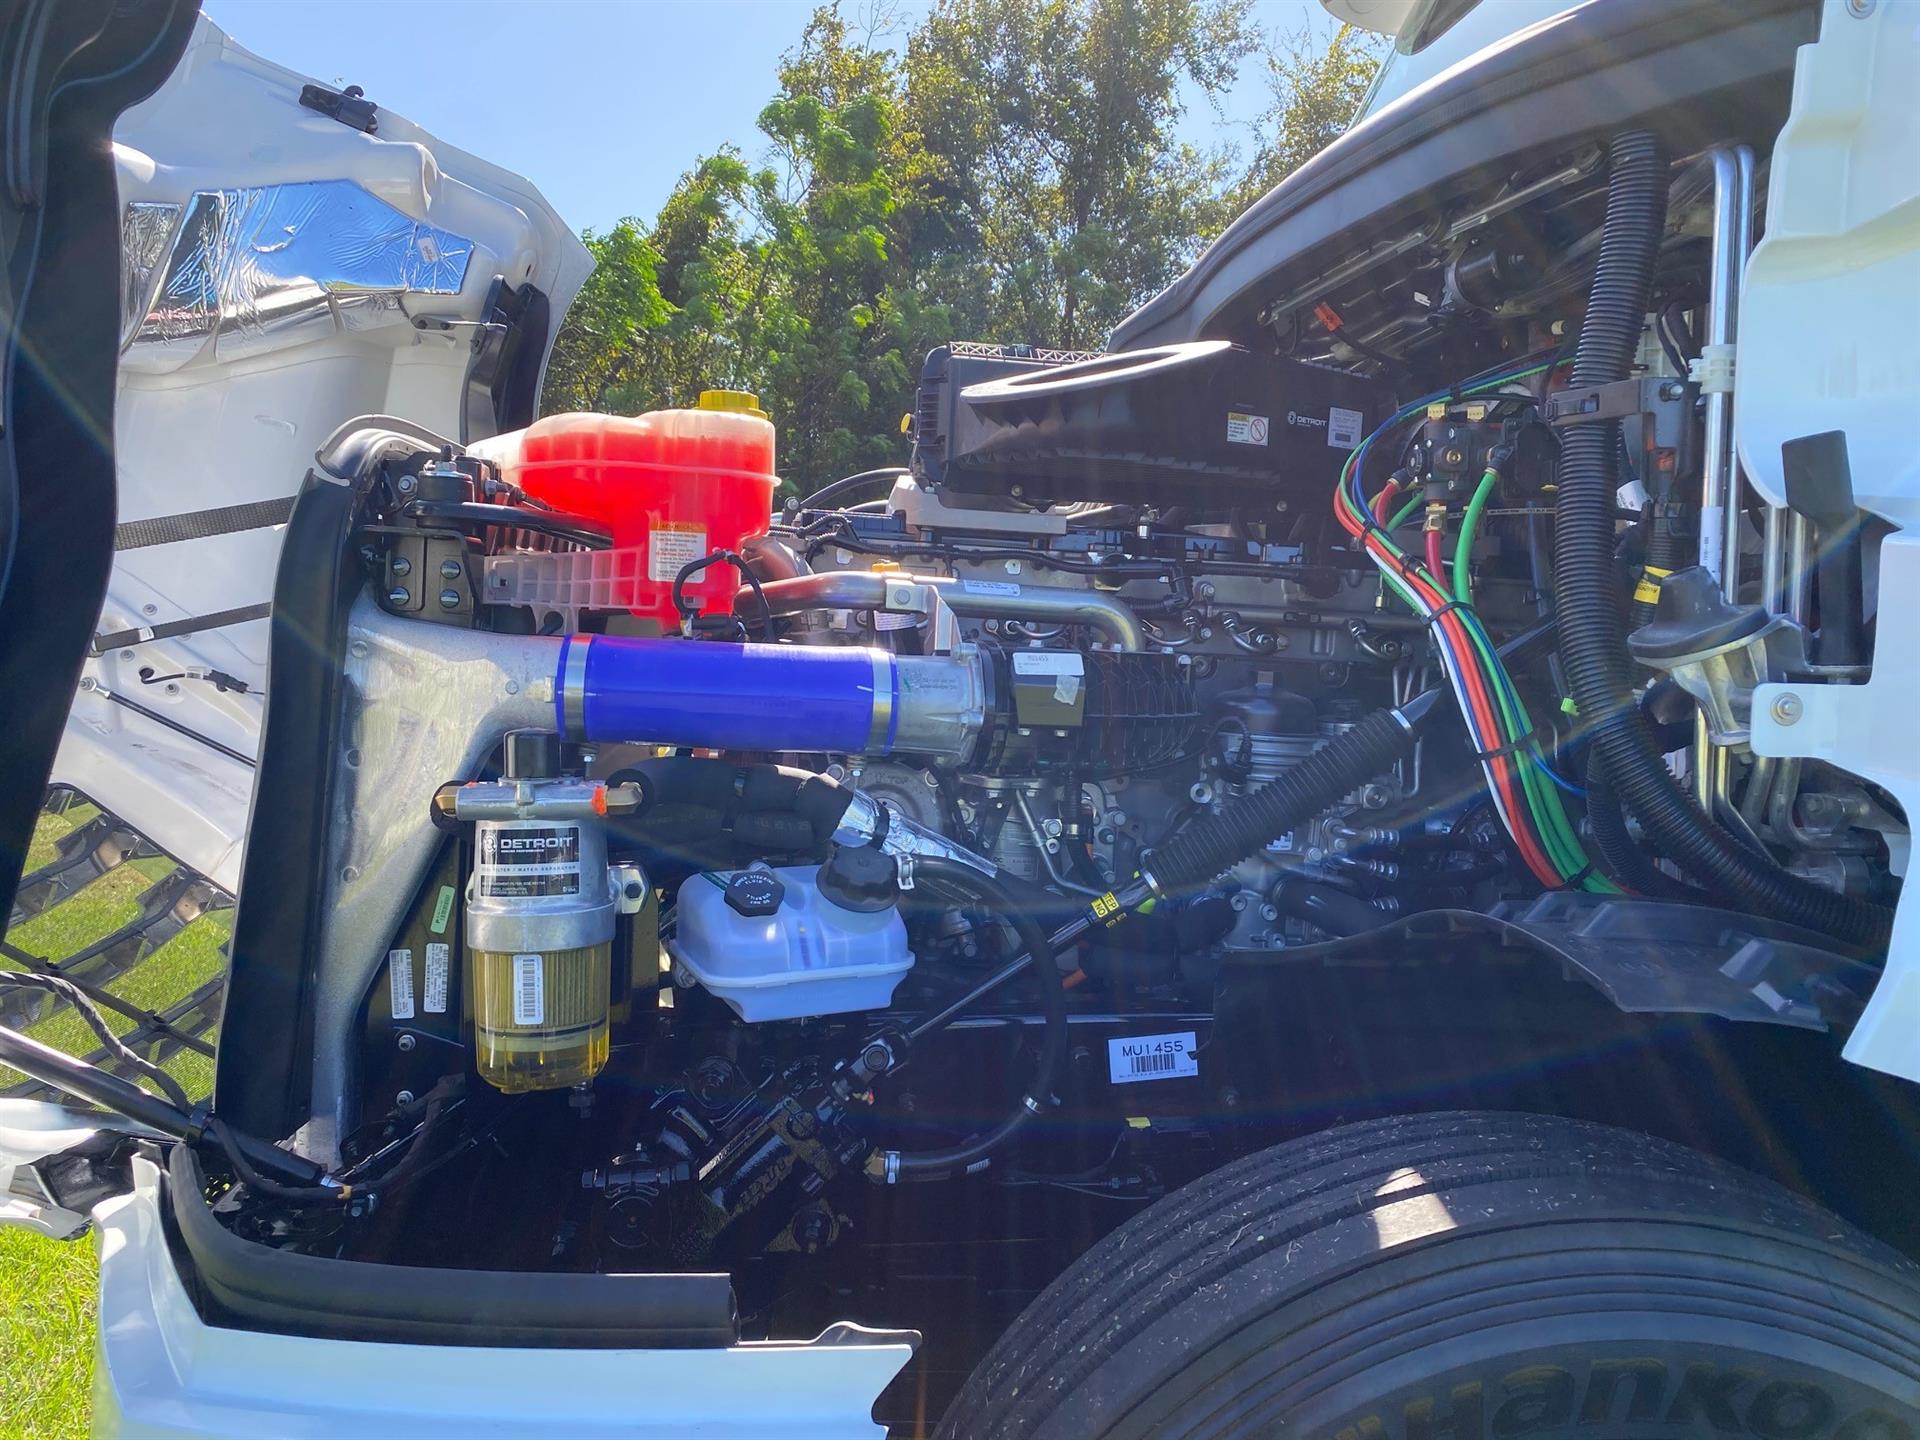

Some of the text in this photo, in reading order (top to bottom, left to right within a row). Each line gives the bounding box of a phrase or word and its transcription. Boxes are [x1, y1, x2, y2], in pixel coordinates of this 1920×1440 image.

[1296, 415, 1328, 426] DETROIT
[500, 836, 573, 849] DETROIT
[1122, 1040, 1184, 1057] MU1455
